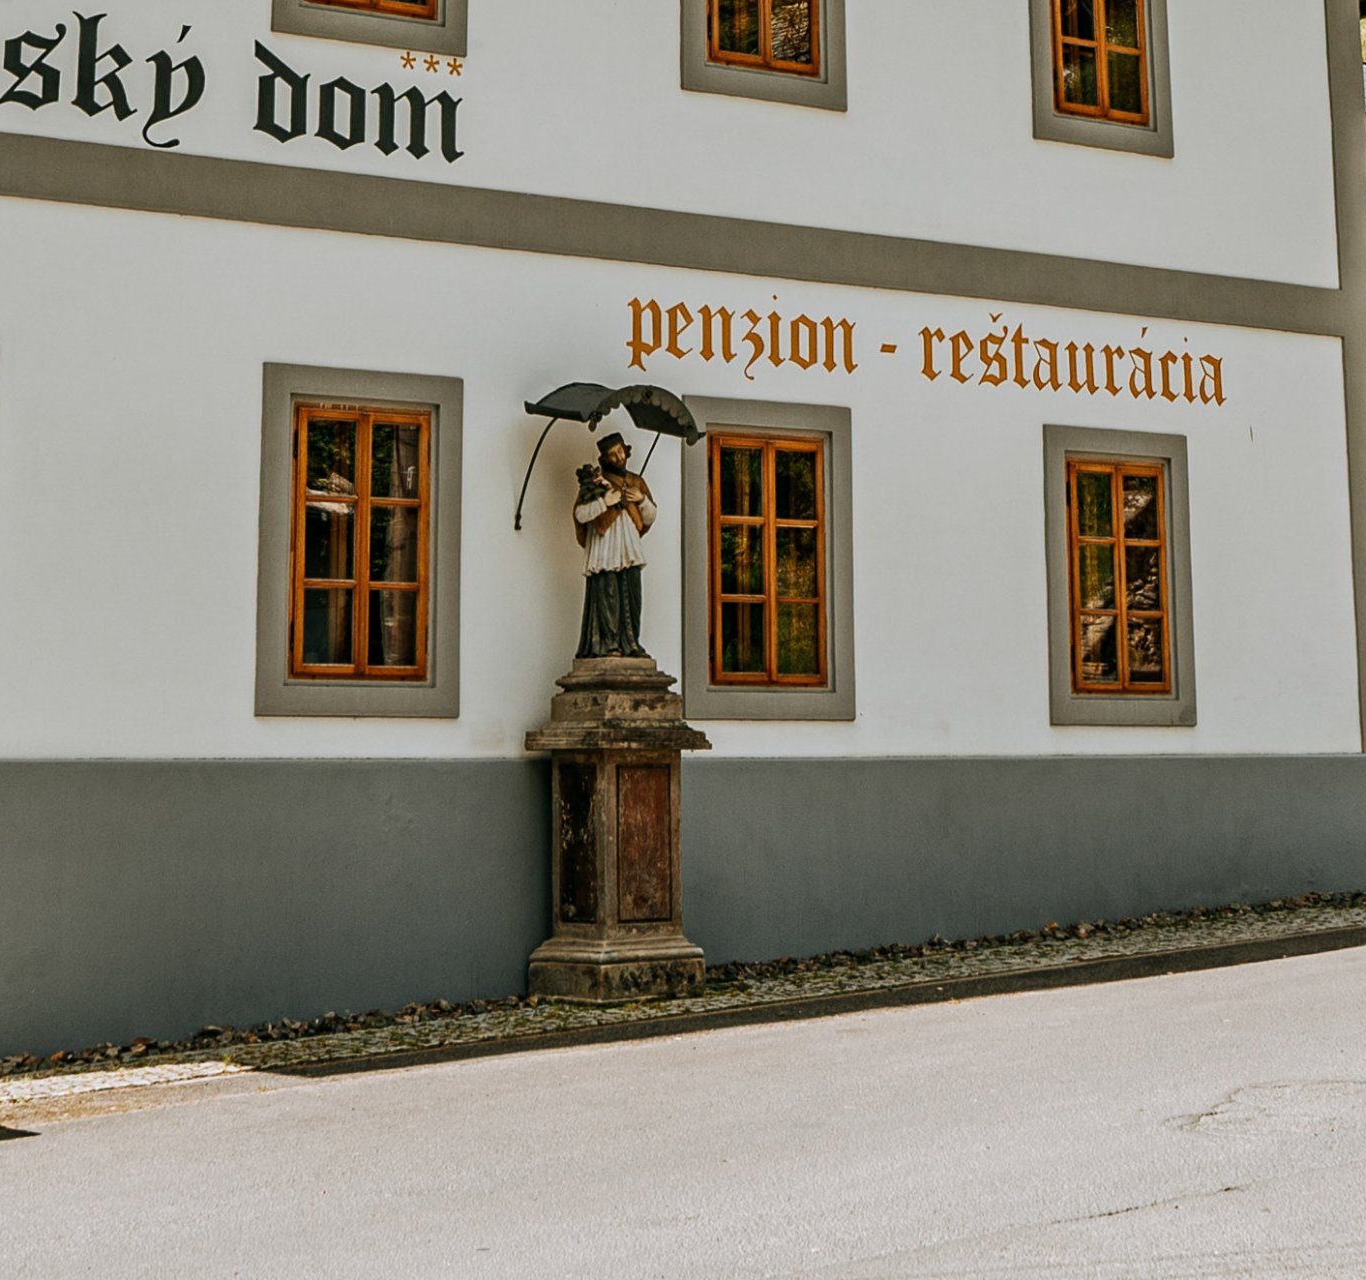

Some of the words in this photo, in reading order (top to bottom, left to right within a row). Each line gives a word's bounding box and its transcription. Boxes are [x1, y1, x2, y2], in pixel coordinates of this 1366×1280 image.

[252, 39, 464, 163] dom
[627, 294, 858, 381] penzion
[918, 312, 1227, 408] reštaurácia
